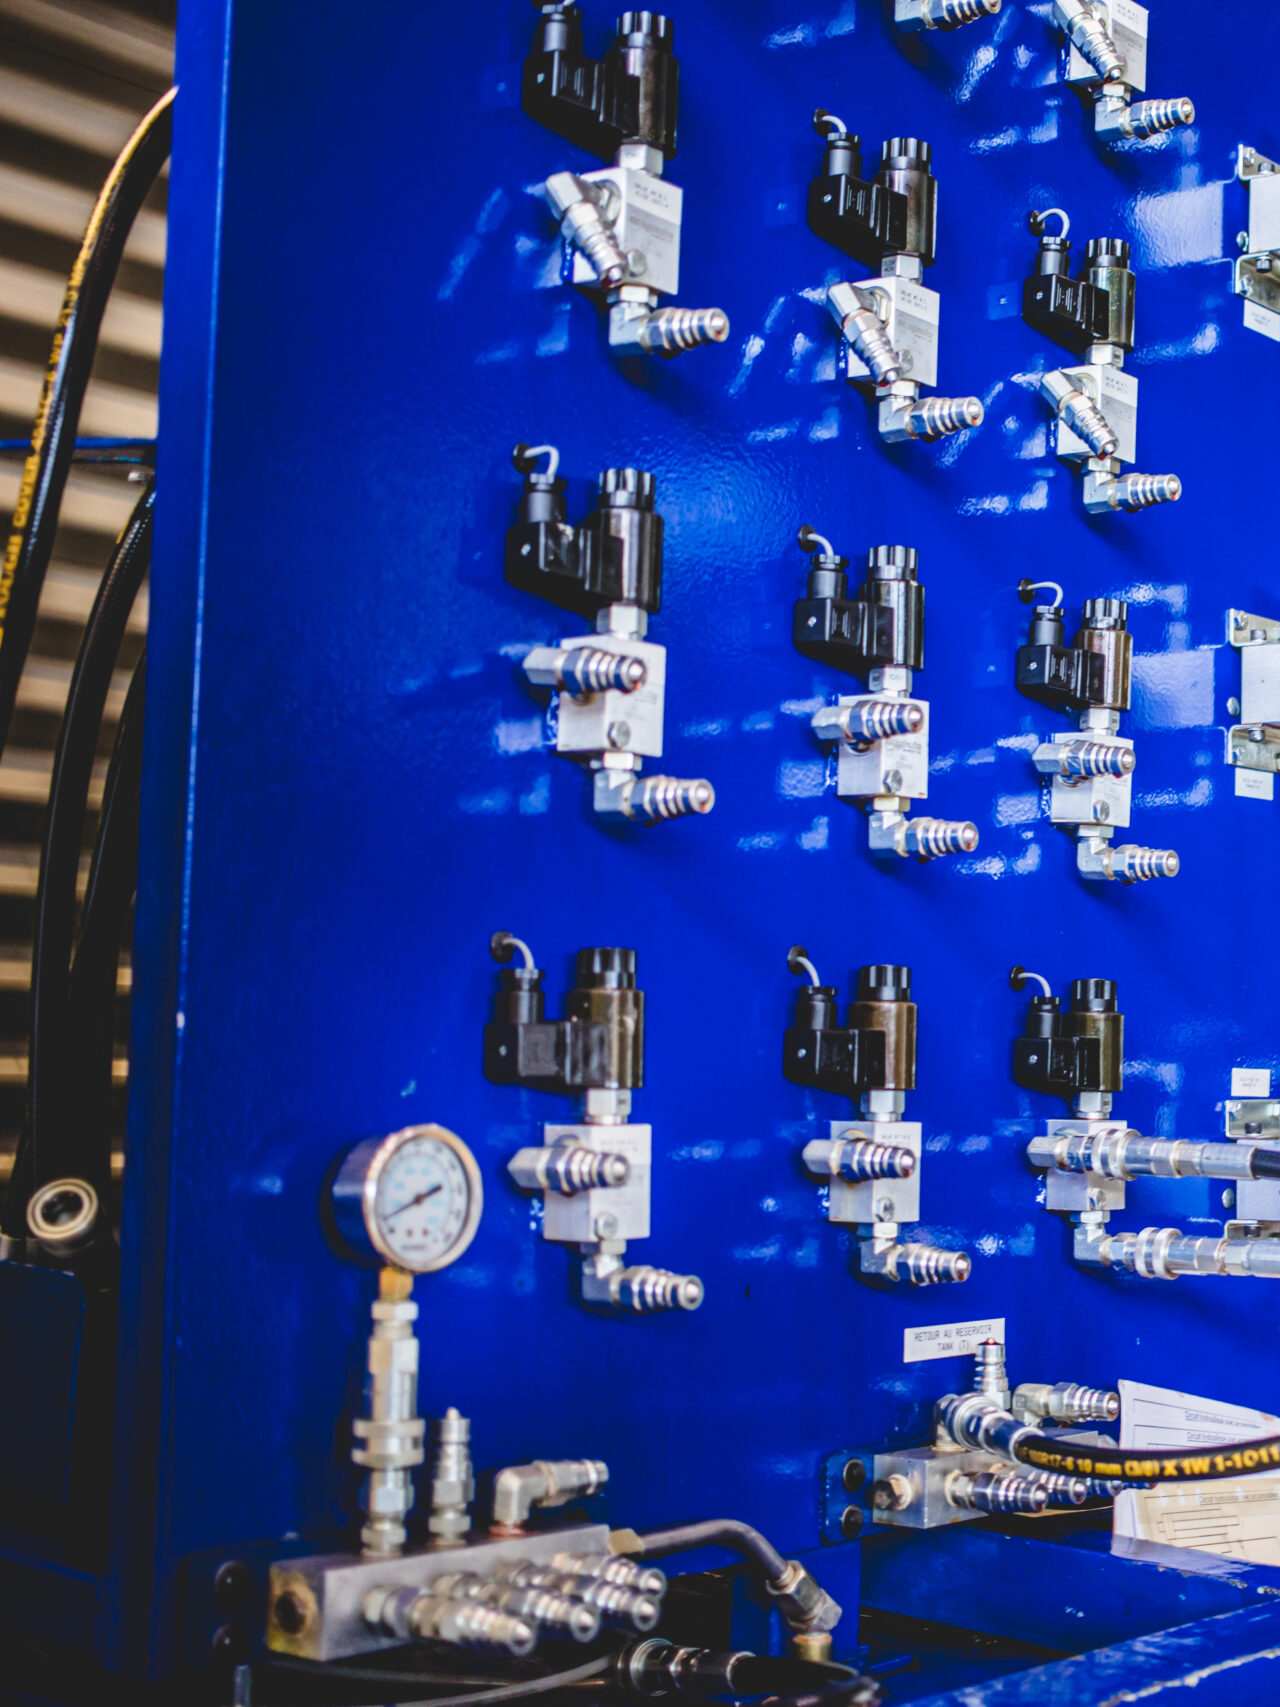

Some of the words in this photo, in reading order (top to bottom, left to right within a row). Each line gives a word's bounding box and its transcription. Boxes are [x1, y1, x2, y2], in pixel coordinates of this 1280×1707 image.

[1094, 1462, 1122, 1476] mm
[1163, 1460, 1178, 1477] X
[1181, 1457, 1211, 1475] 1W
[1214, 1445, 1280, 1472] 1-1011
